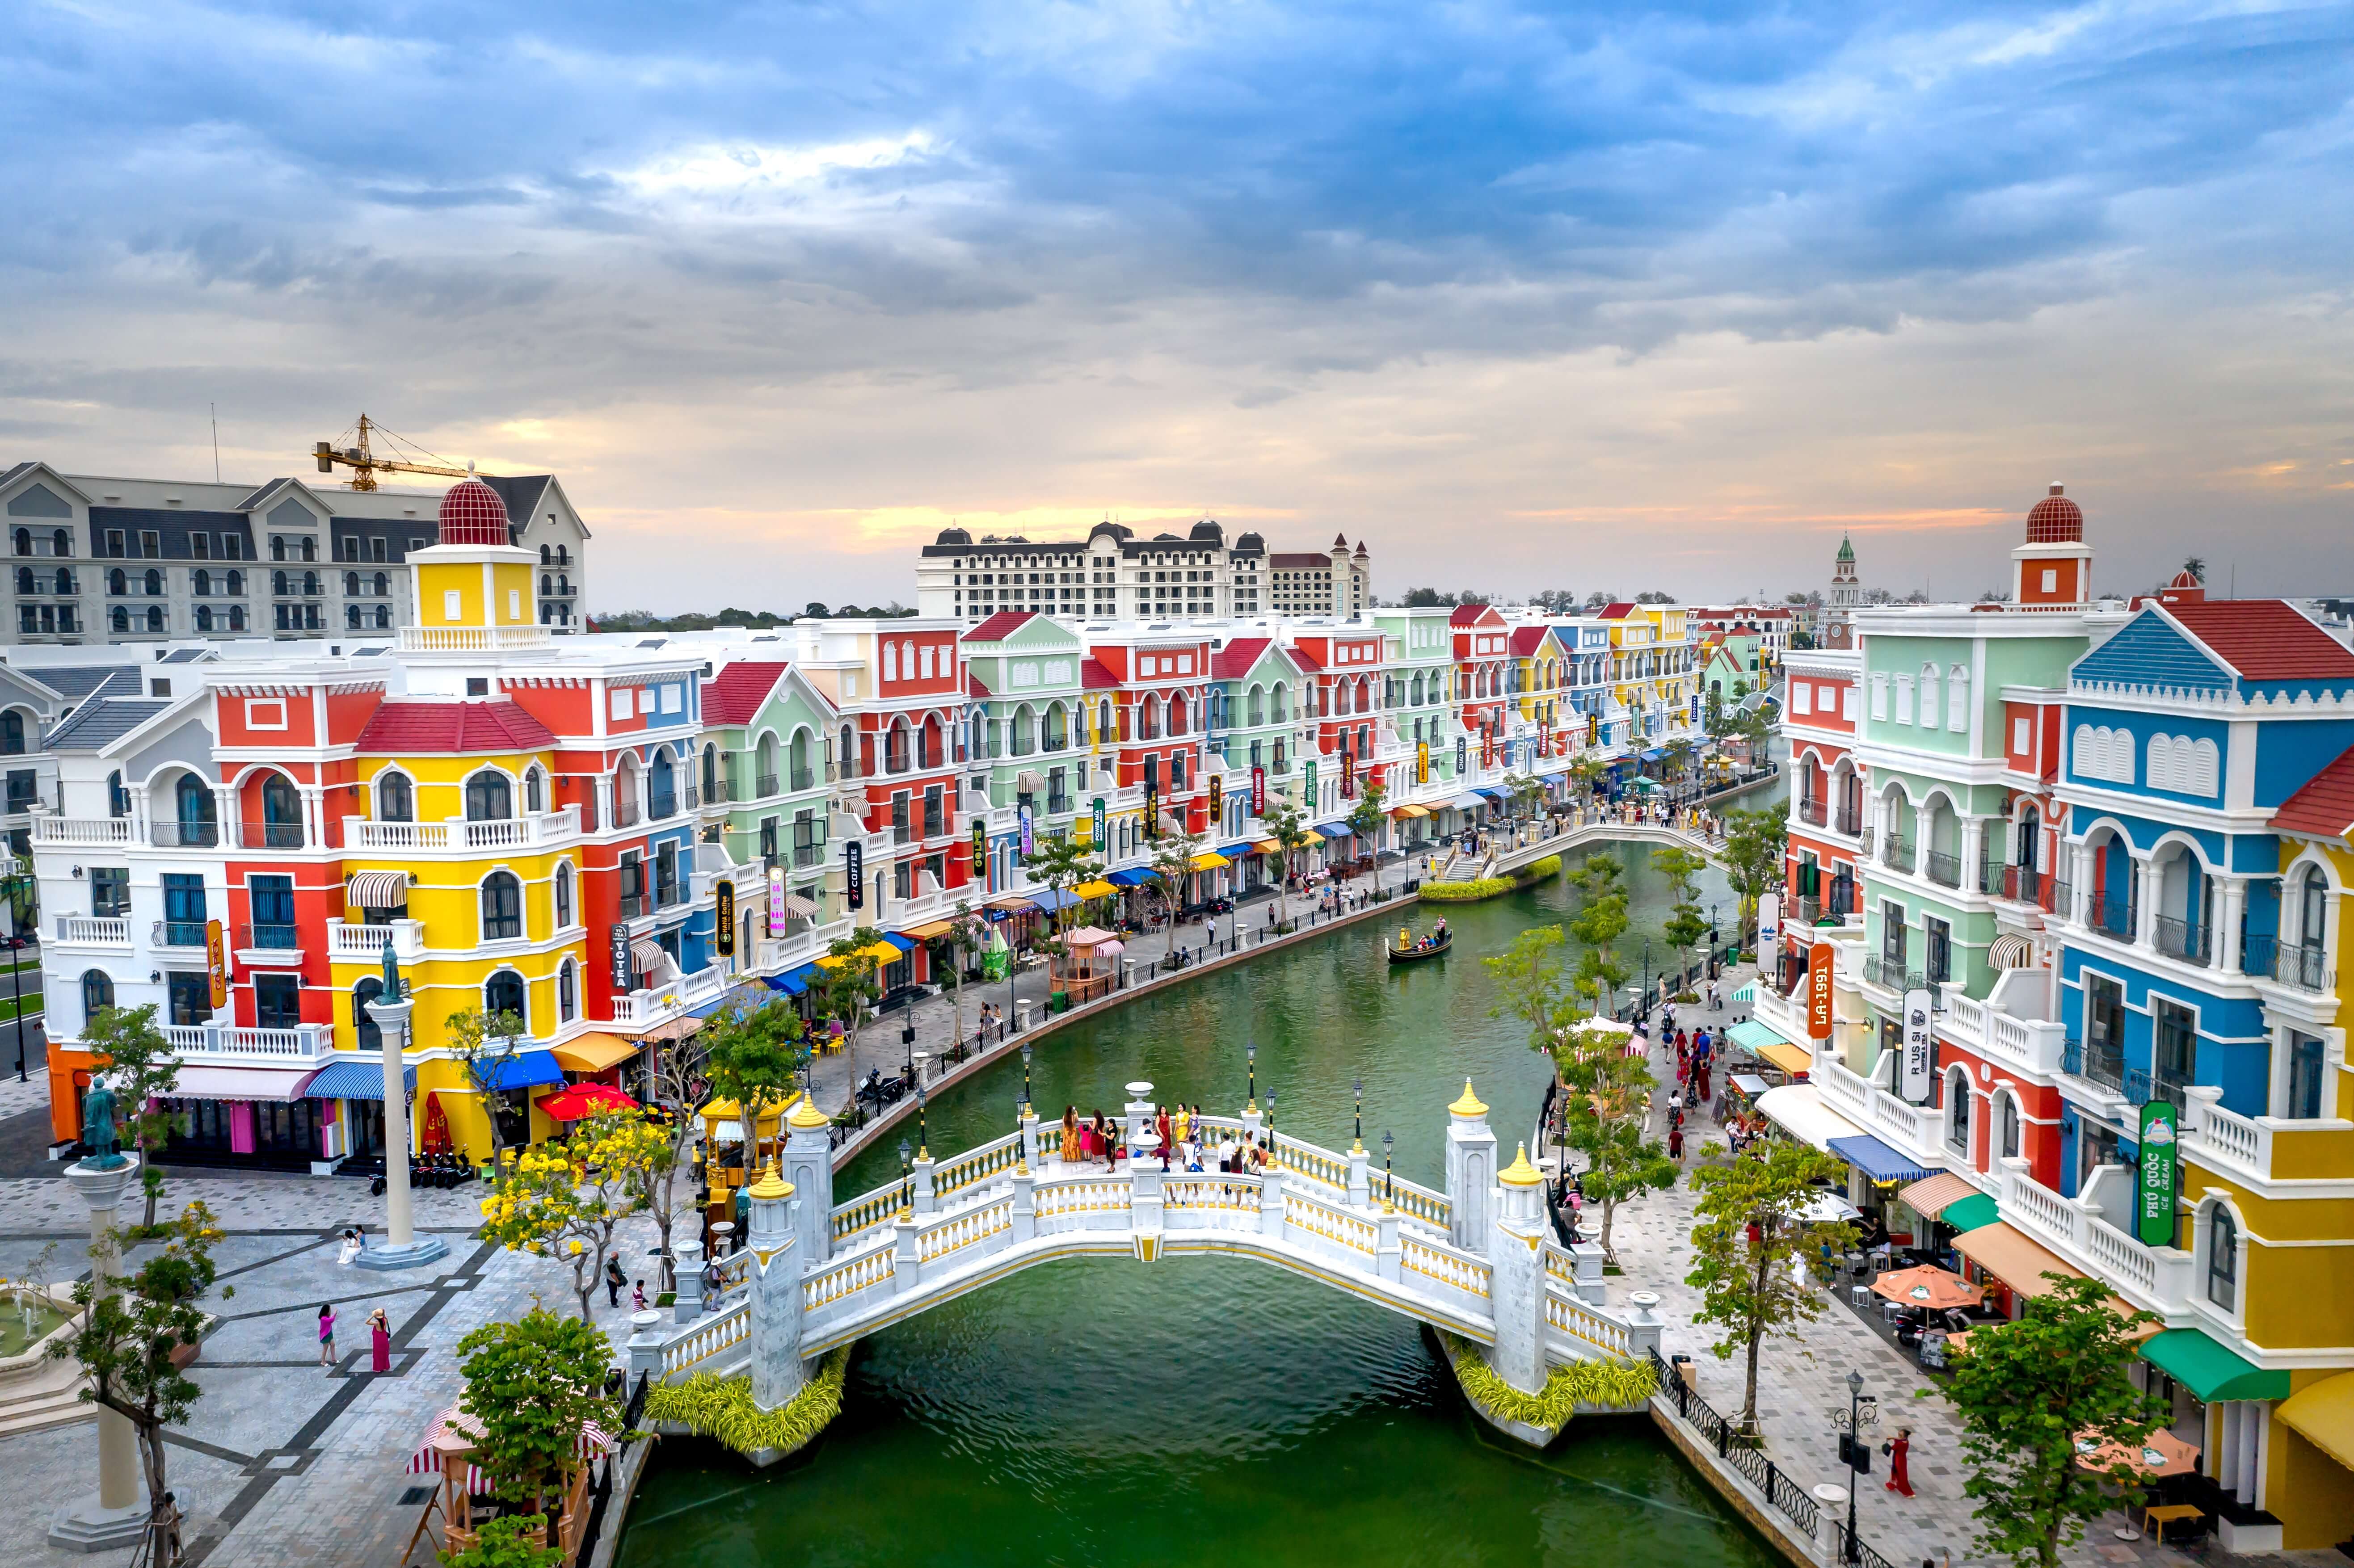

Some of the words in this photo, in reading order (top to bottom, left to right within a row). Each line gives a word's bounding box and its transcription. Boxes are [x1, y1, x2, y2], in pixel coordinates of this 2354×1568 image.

[615, 942, 626, 986] YOTEA
[1815, 967, 1828, 1025] LA-1991
[2143, 1153, 2160, 1188] QUỐC
[2162, 1159, 2170, 1190] CREAM
[2143, 1192, 2159, 1219] PHÚ
[2161, 1196, 2169, 1210] ICE
